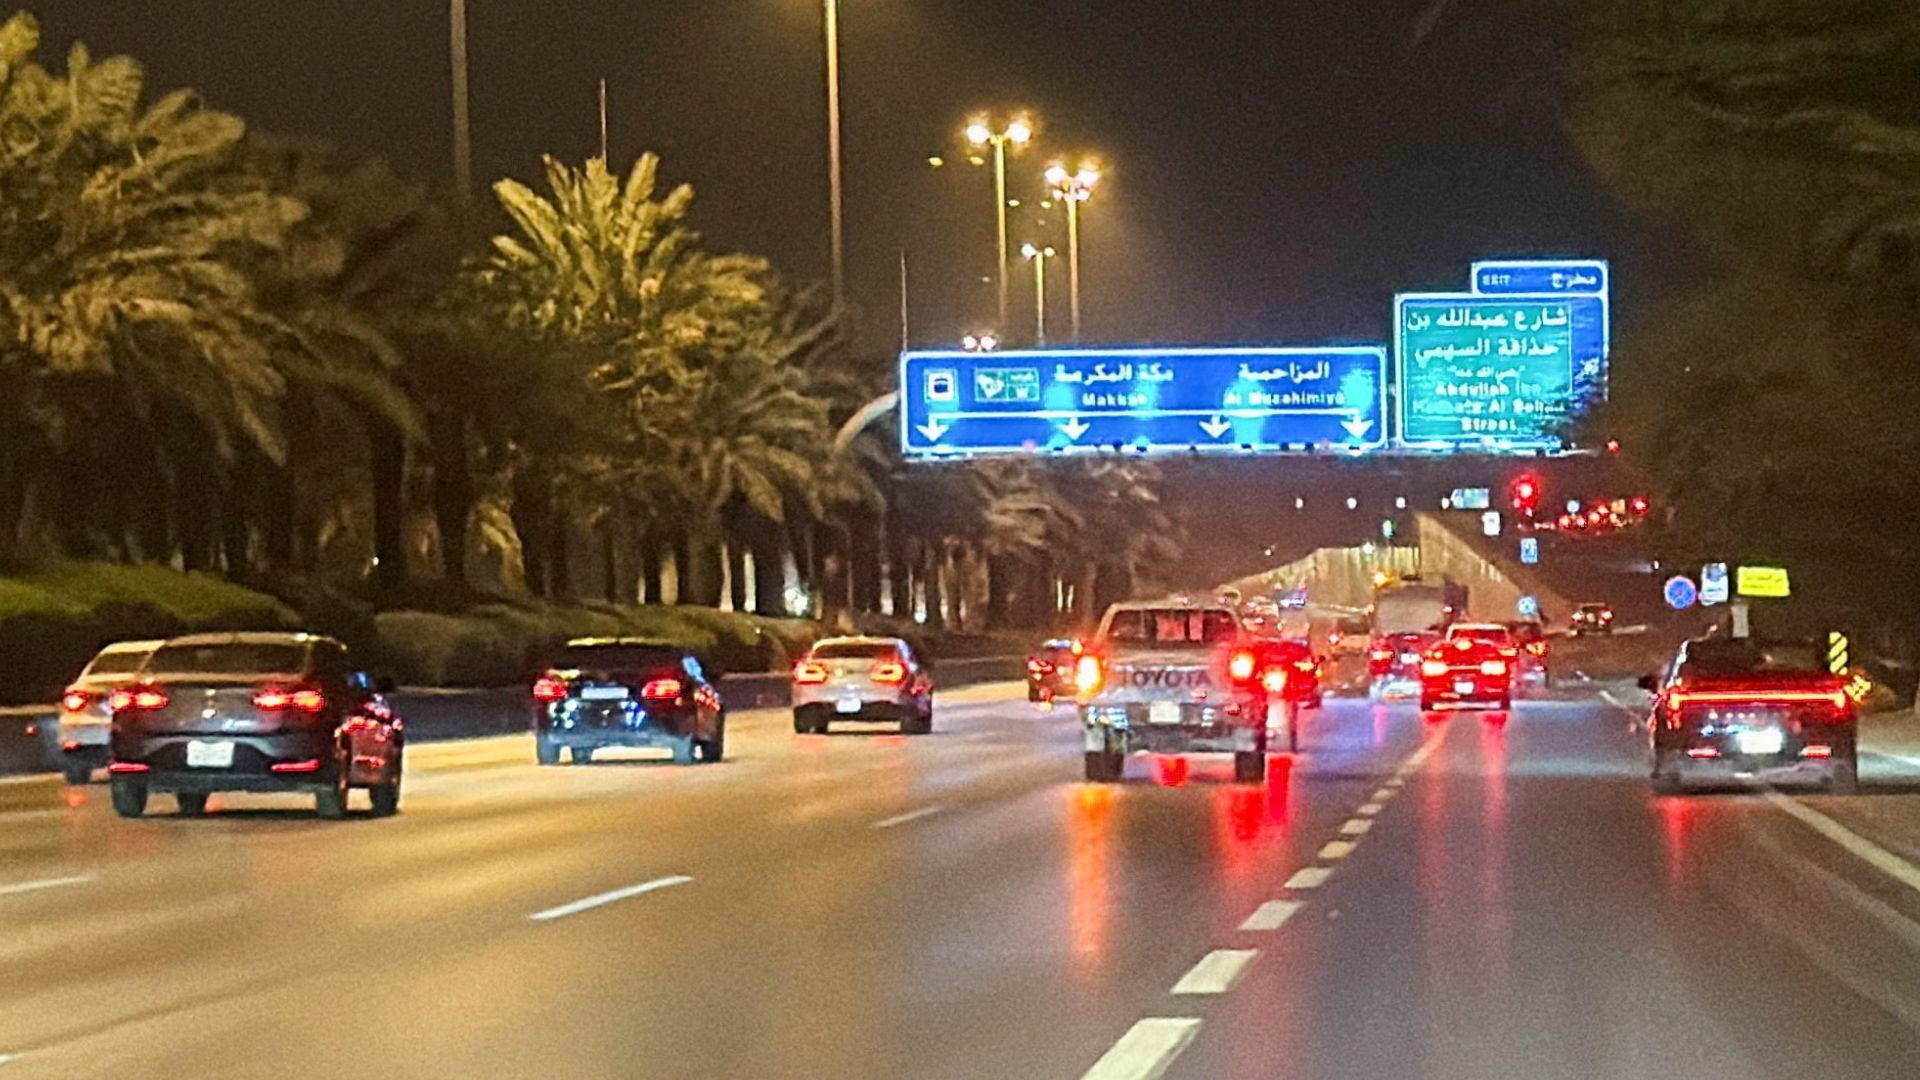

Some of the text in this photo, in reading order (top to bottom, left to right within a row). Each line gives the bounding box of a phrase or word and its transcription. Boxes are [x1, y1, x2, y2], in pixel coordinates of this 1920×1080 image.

[1482, 274, 1511, 286] EXIT
[1551, 272, 1598, 288] مخرج
[1406, 307, 1568, 332] شارع عبدالله بن
[1137, 362, 1175, 381] مكة
[1117, 669, 1212, 688] TOYOTA
